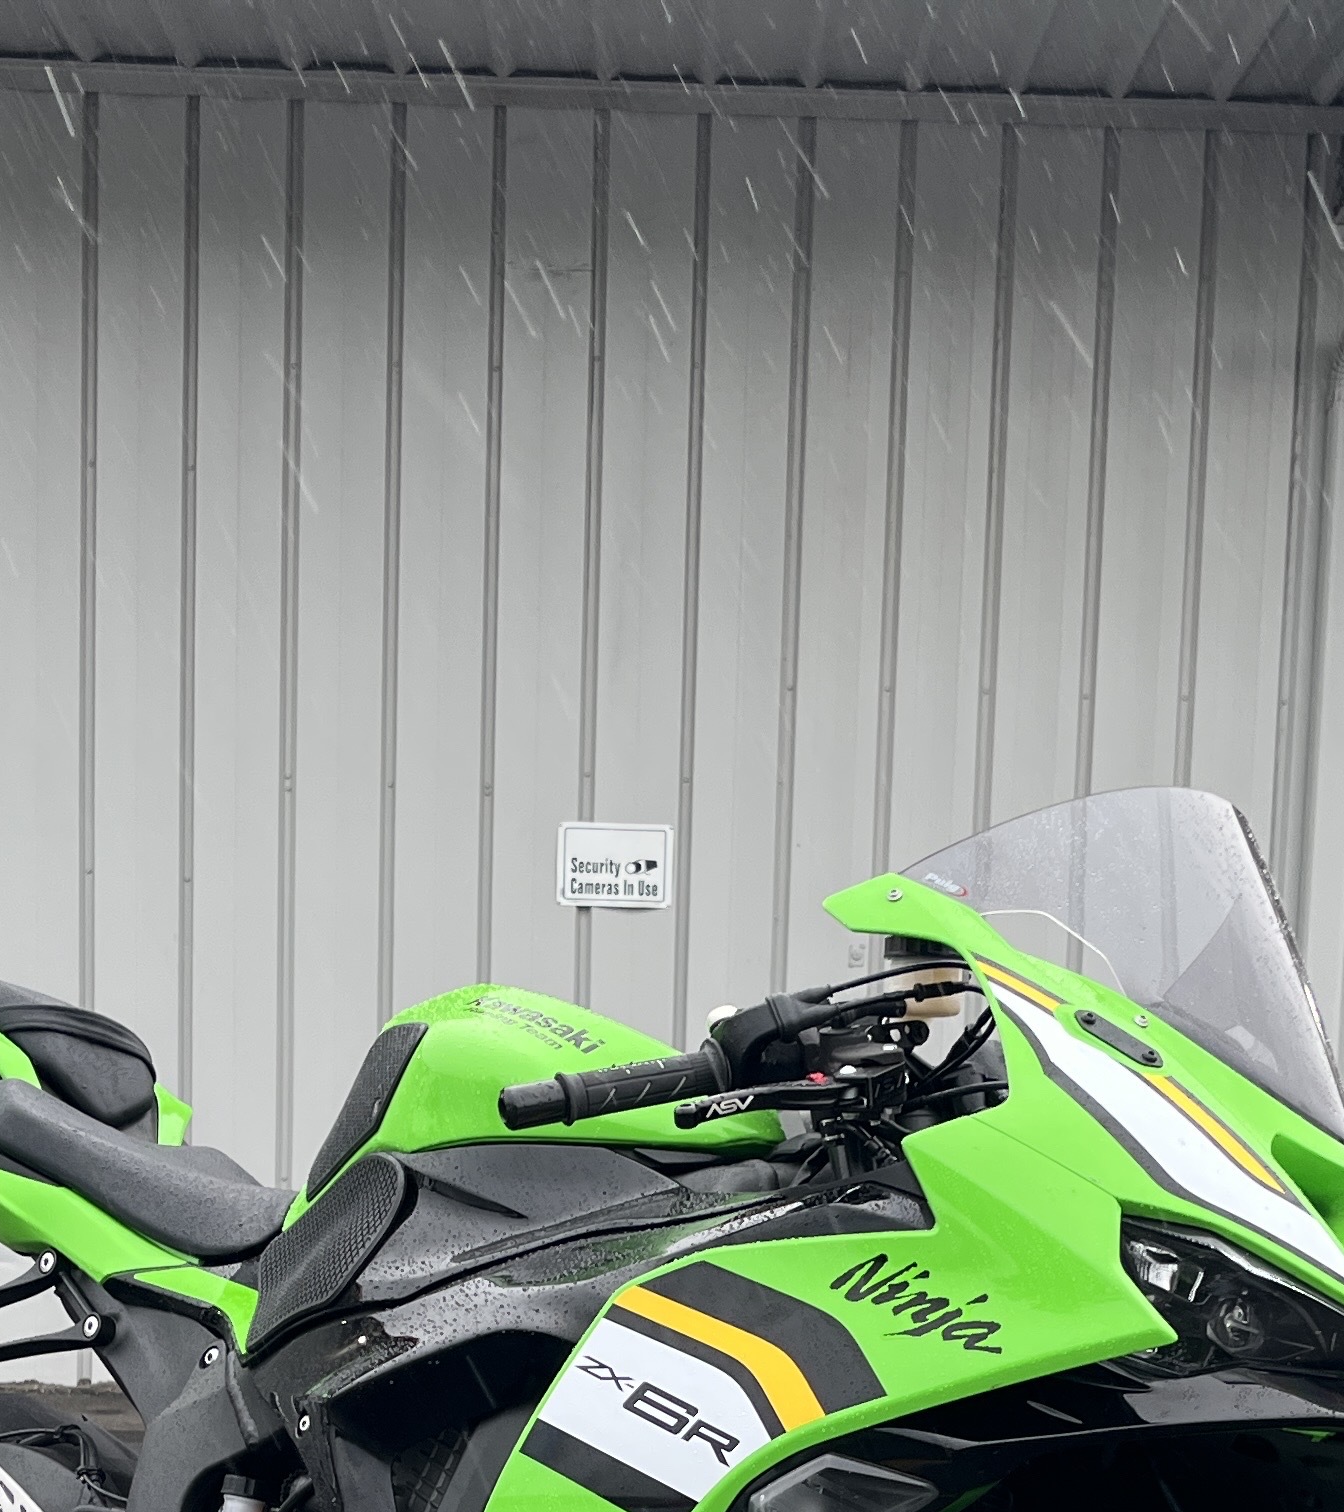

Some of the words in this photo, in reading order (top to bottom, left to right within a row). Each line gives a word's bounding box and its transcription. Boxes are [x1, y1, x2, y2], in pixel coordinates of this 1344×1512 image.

[571, 857, 621, 878] Security
[570, 878, 619, 895] Cameras
[623, 880, 634, 896] In
[638, 880, 658, 897] Use
[464, 996, 607, 1054] Kawasaki
[705, 1095, 755, 1119] ASV
[829, 1252, 1003, 1355] Ninja
